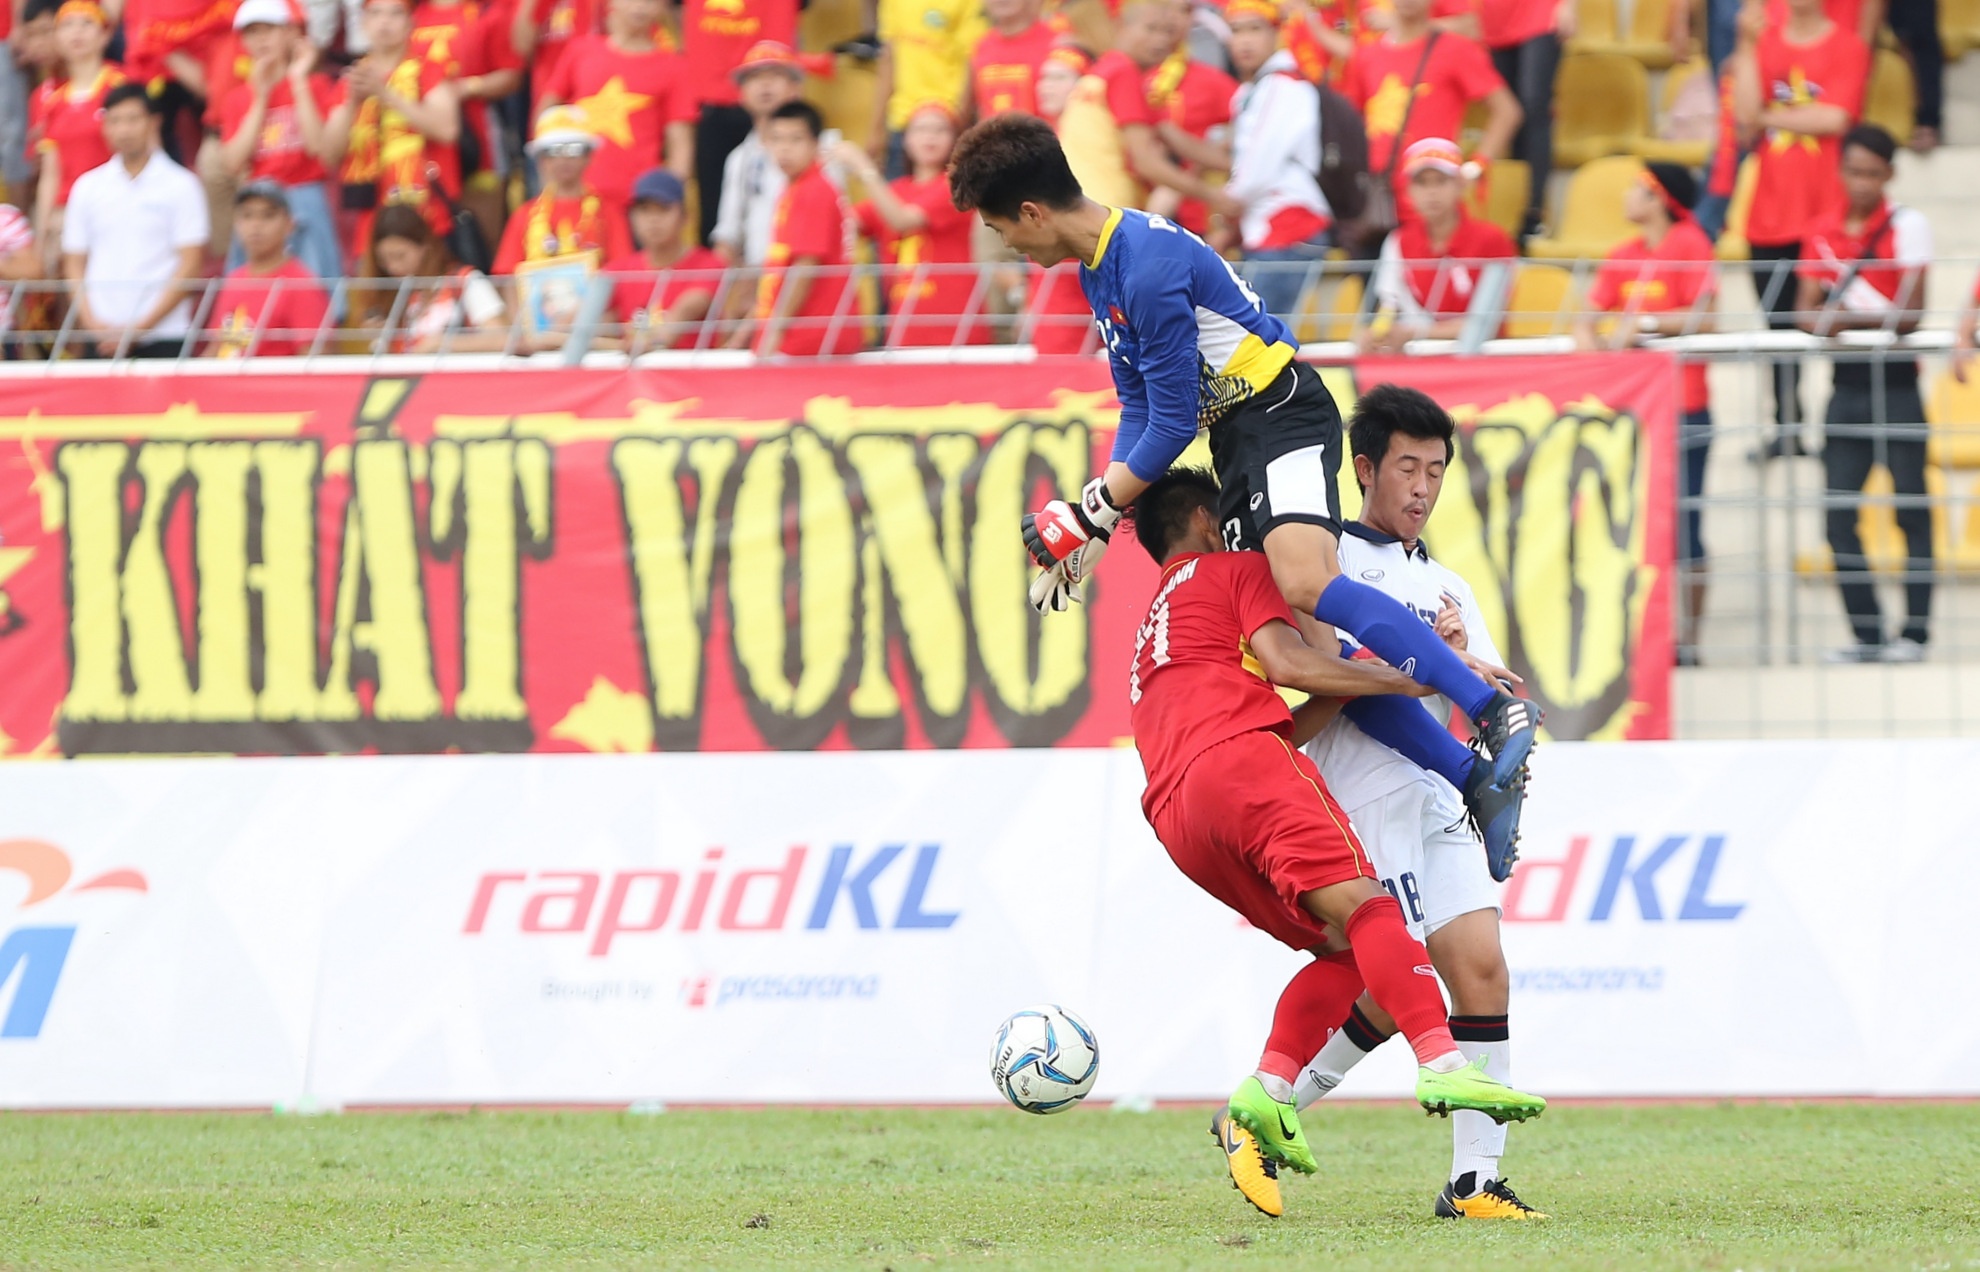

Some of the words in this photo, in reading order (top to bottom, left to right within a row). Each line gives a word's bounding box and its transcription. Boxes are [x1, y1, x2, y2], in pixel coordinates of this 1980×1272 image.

[55, 375, 554, 750] KHÁT
[461, 841, 962, 957] rapidKL
[715, 972, 881, 1006] prasarana
